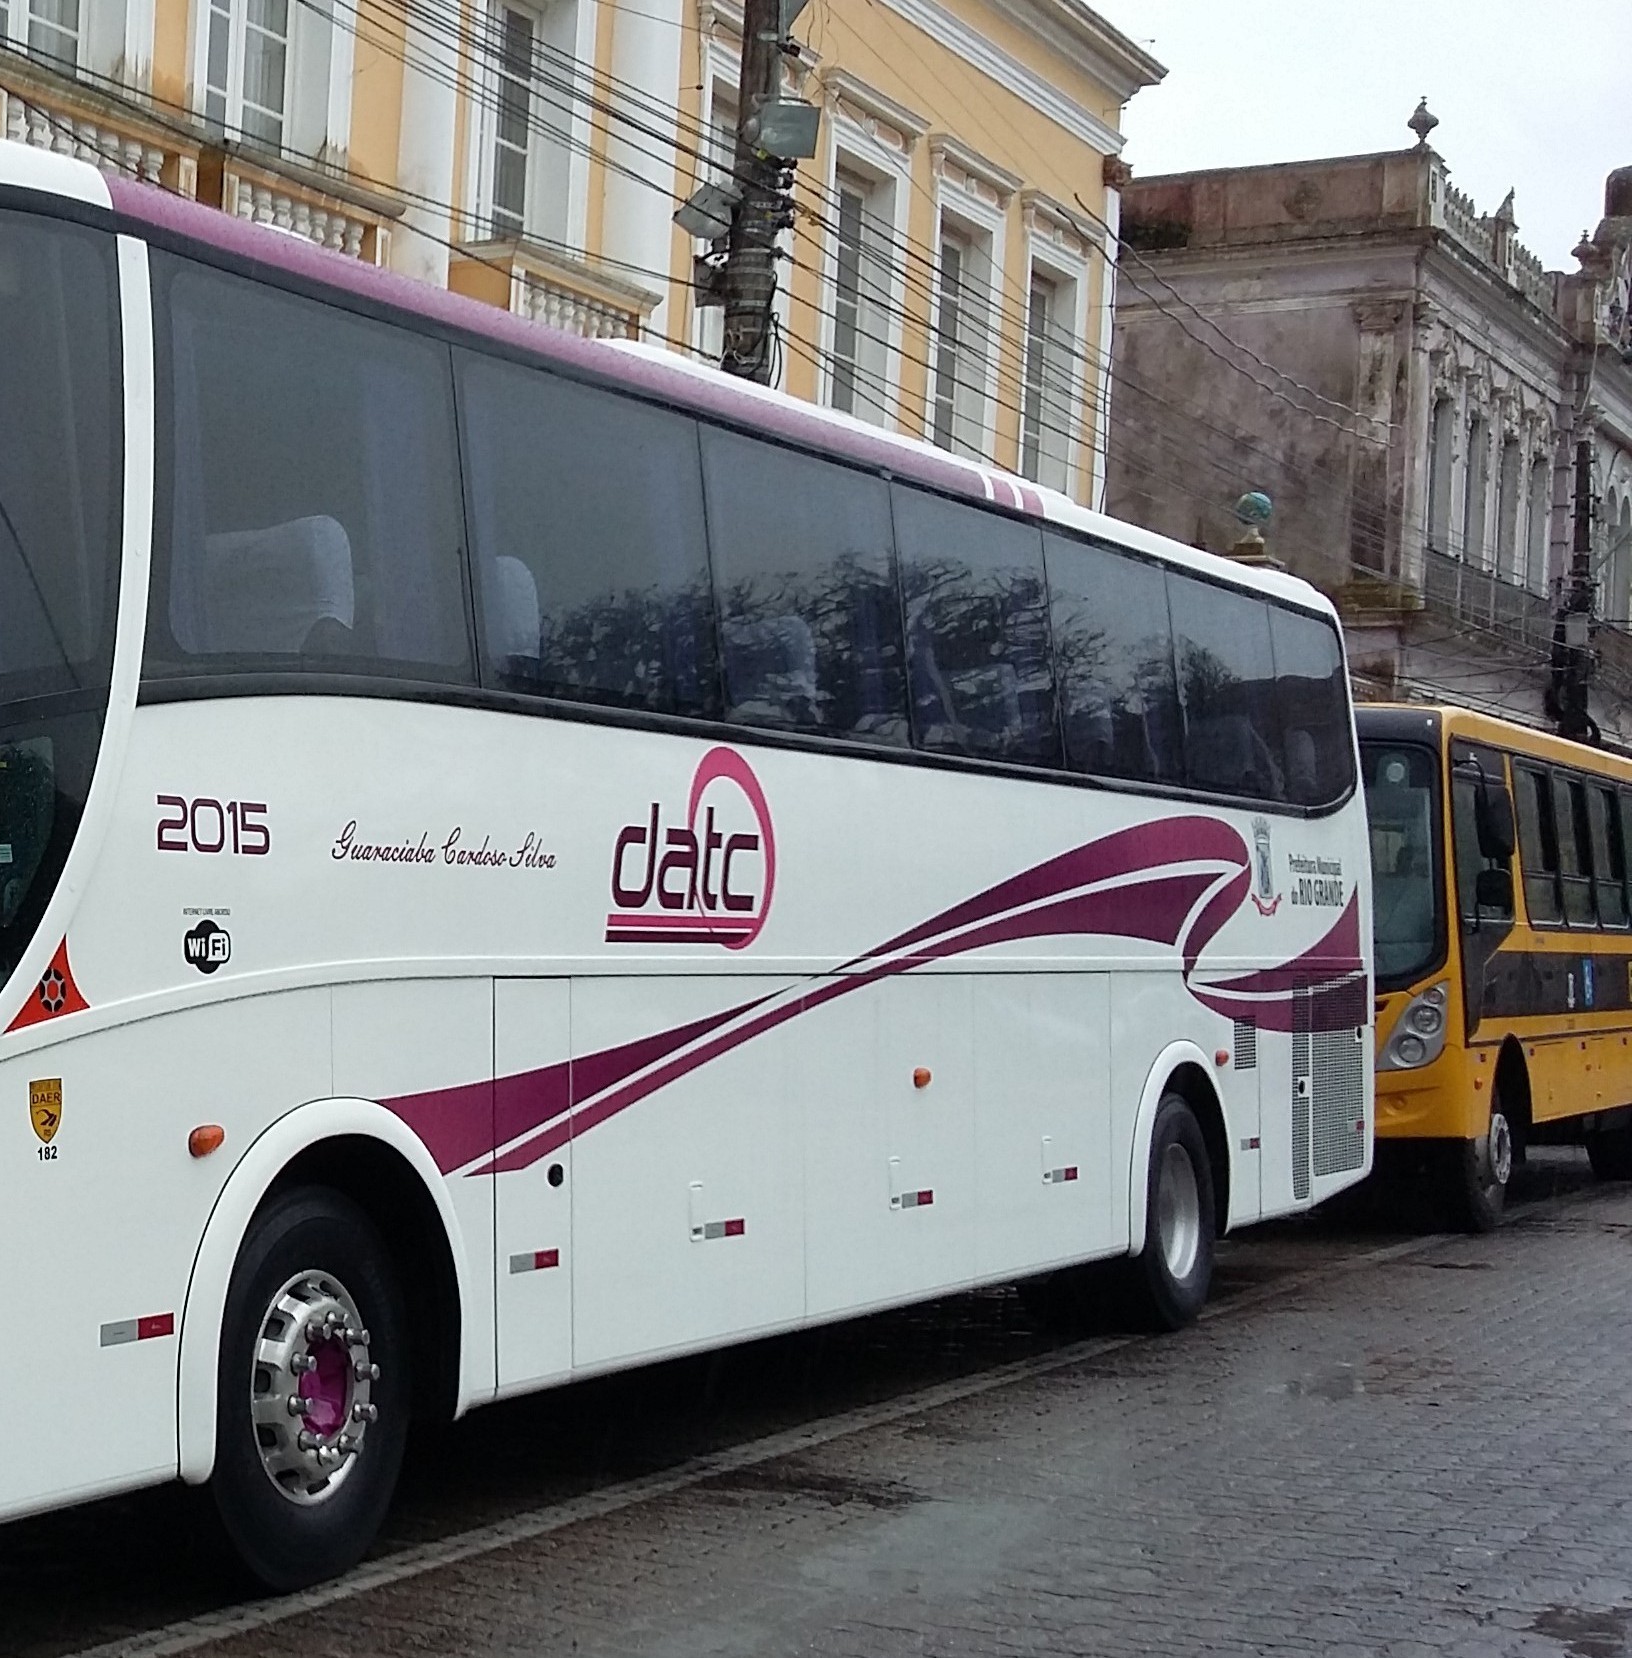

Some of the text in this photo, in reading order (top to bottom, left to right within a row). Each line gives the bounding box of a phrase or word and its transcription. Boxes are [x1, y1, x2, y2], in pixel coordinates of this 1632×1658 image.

[155, 793, 272, 856] 2015
[331, 820, 558, 869] Guaraciaba Cardoso Silva
[611, 801, 760, 913] datc
[1299, 877, 1313, 906] RIO
[1313, 878, 1344, 907] GRANDE
[32, 1092, 61, 1104] DAER
[37, 1145, 58, 1161] 182
